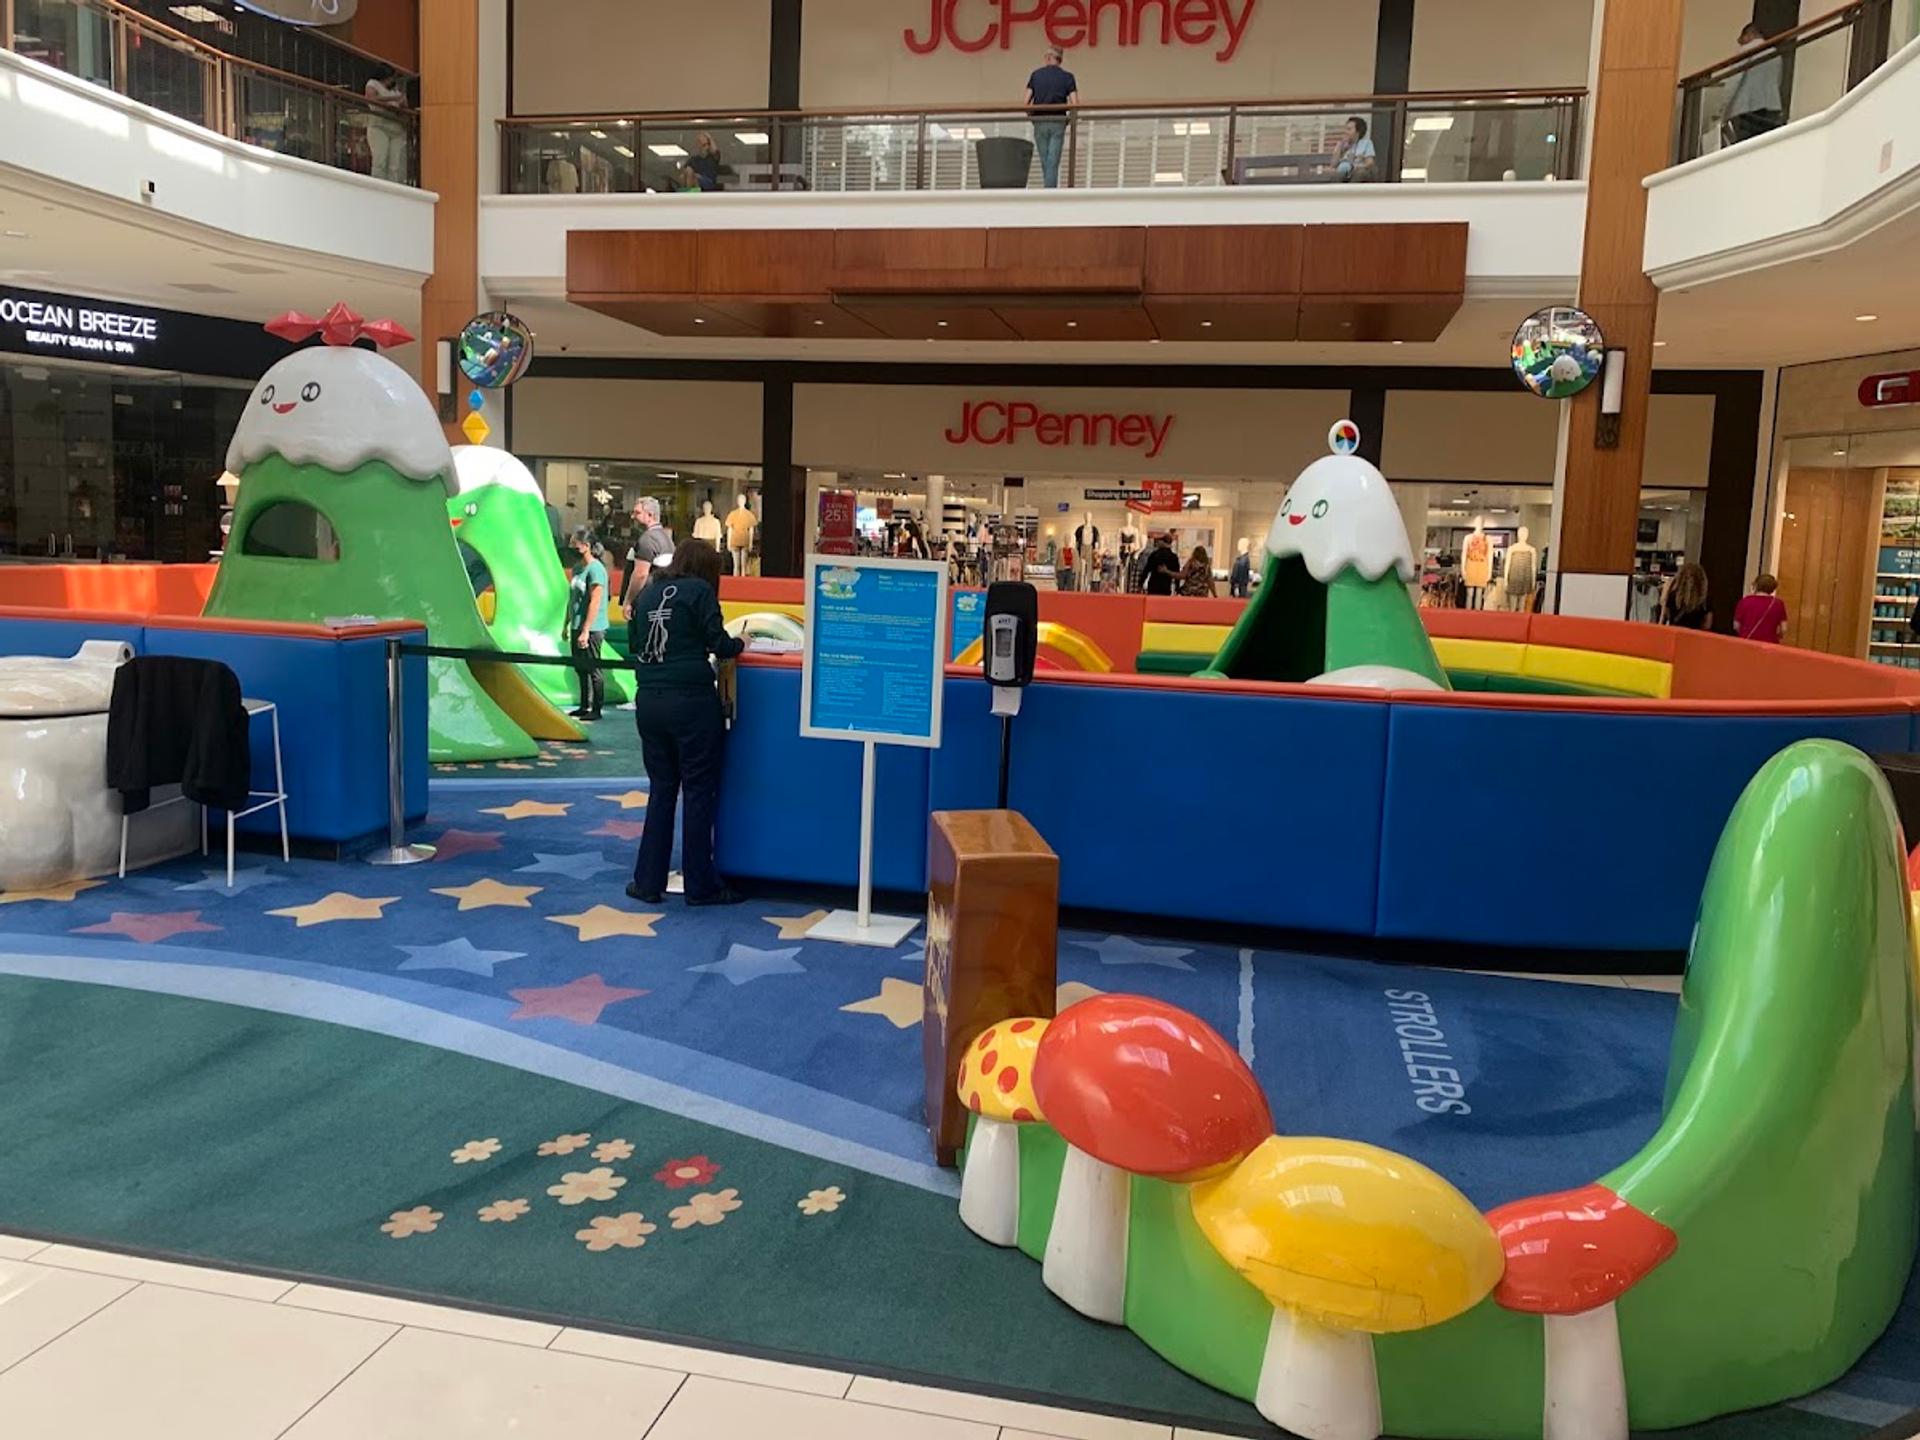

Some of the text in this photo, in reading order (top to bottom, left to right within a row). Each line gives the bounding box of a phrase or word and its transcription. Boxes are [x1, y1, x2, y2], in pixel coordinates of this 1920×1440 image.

[904, 0, 1256, 62] JCPenney
[0, 298, 157, 341] OCEAN BREEZE
[25, 330, 134, 354] BEAUTY SALON & SPA
[945, 401, 1173, 457] JCPenney
[1384, 989, 1472, 1115] STROLLERS
